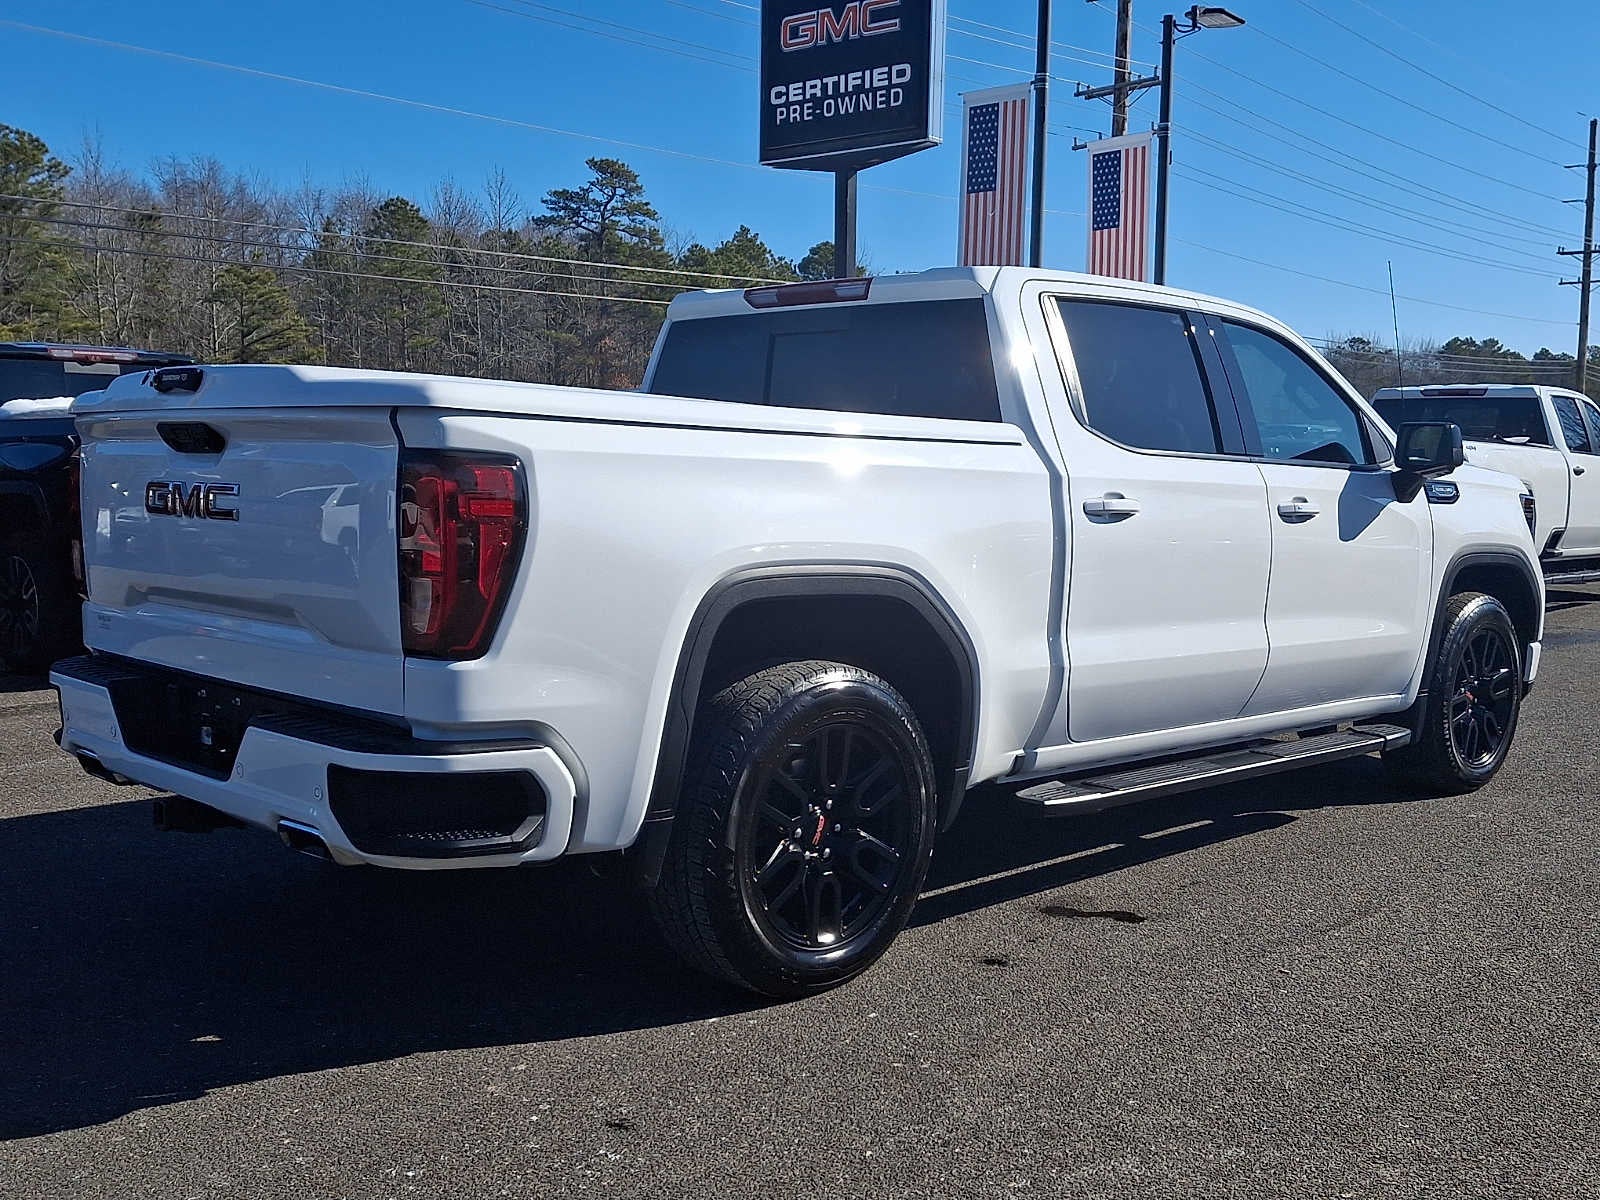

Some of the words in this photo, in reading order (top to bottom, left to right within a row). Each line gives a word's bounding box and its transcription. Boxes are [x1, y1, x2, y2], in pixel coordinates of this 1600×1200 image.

[781, 0, 901, 52] GMC
[770, 63, 911, 105] CERTIFIED
[776, 88, 903, 126] PRE-OWNED
[145, 481, 240, 521] GMC
